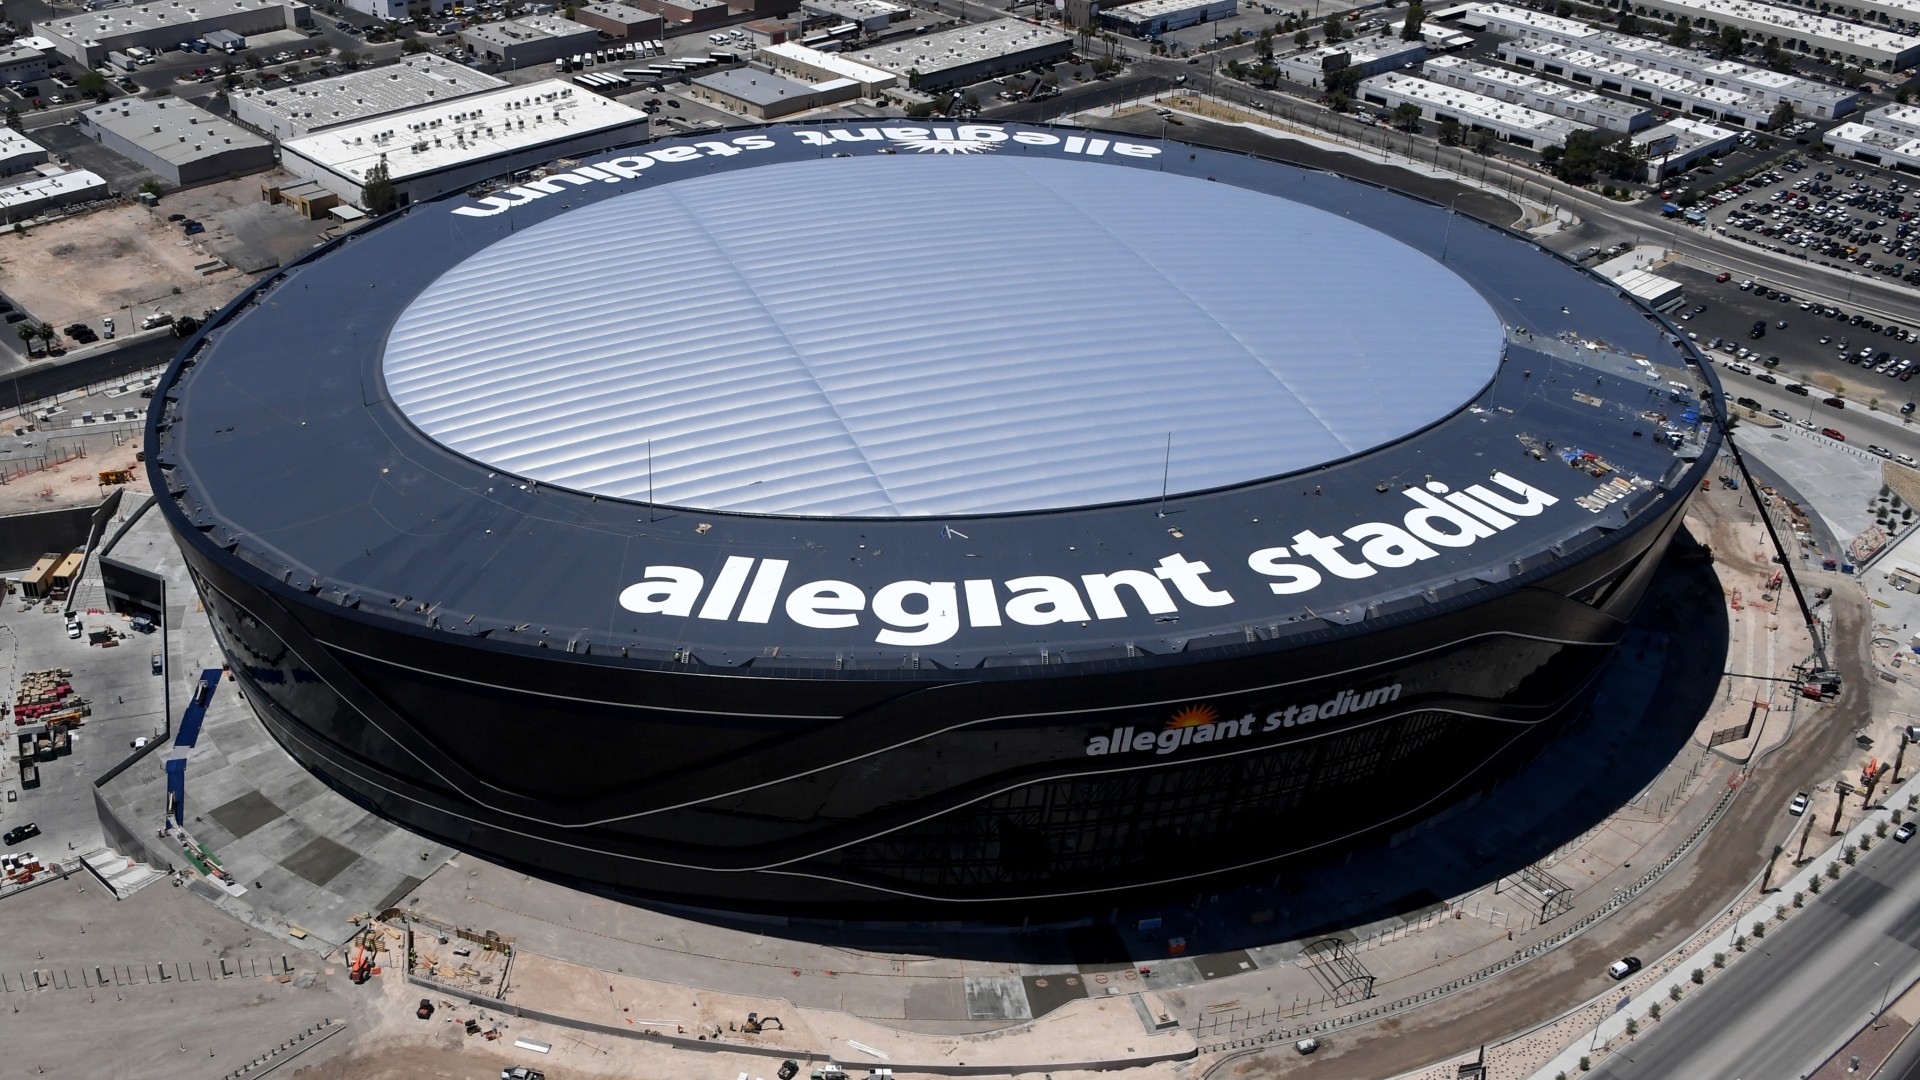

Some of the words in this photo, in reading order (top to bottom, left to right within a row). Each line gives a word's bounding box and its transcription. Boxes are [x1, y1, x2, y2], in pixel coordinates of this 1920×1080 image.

[451, 135, 776, 217] stadium
[793, 125, 1162, 158] allegiant
[619, 553, 1234, 646] allegiant
[1248, 471, 1560, 595] stadiu
[1086, 714, 1256, 756] allegiant
[1263, 684, 1401, 732] stadium
